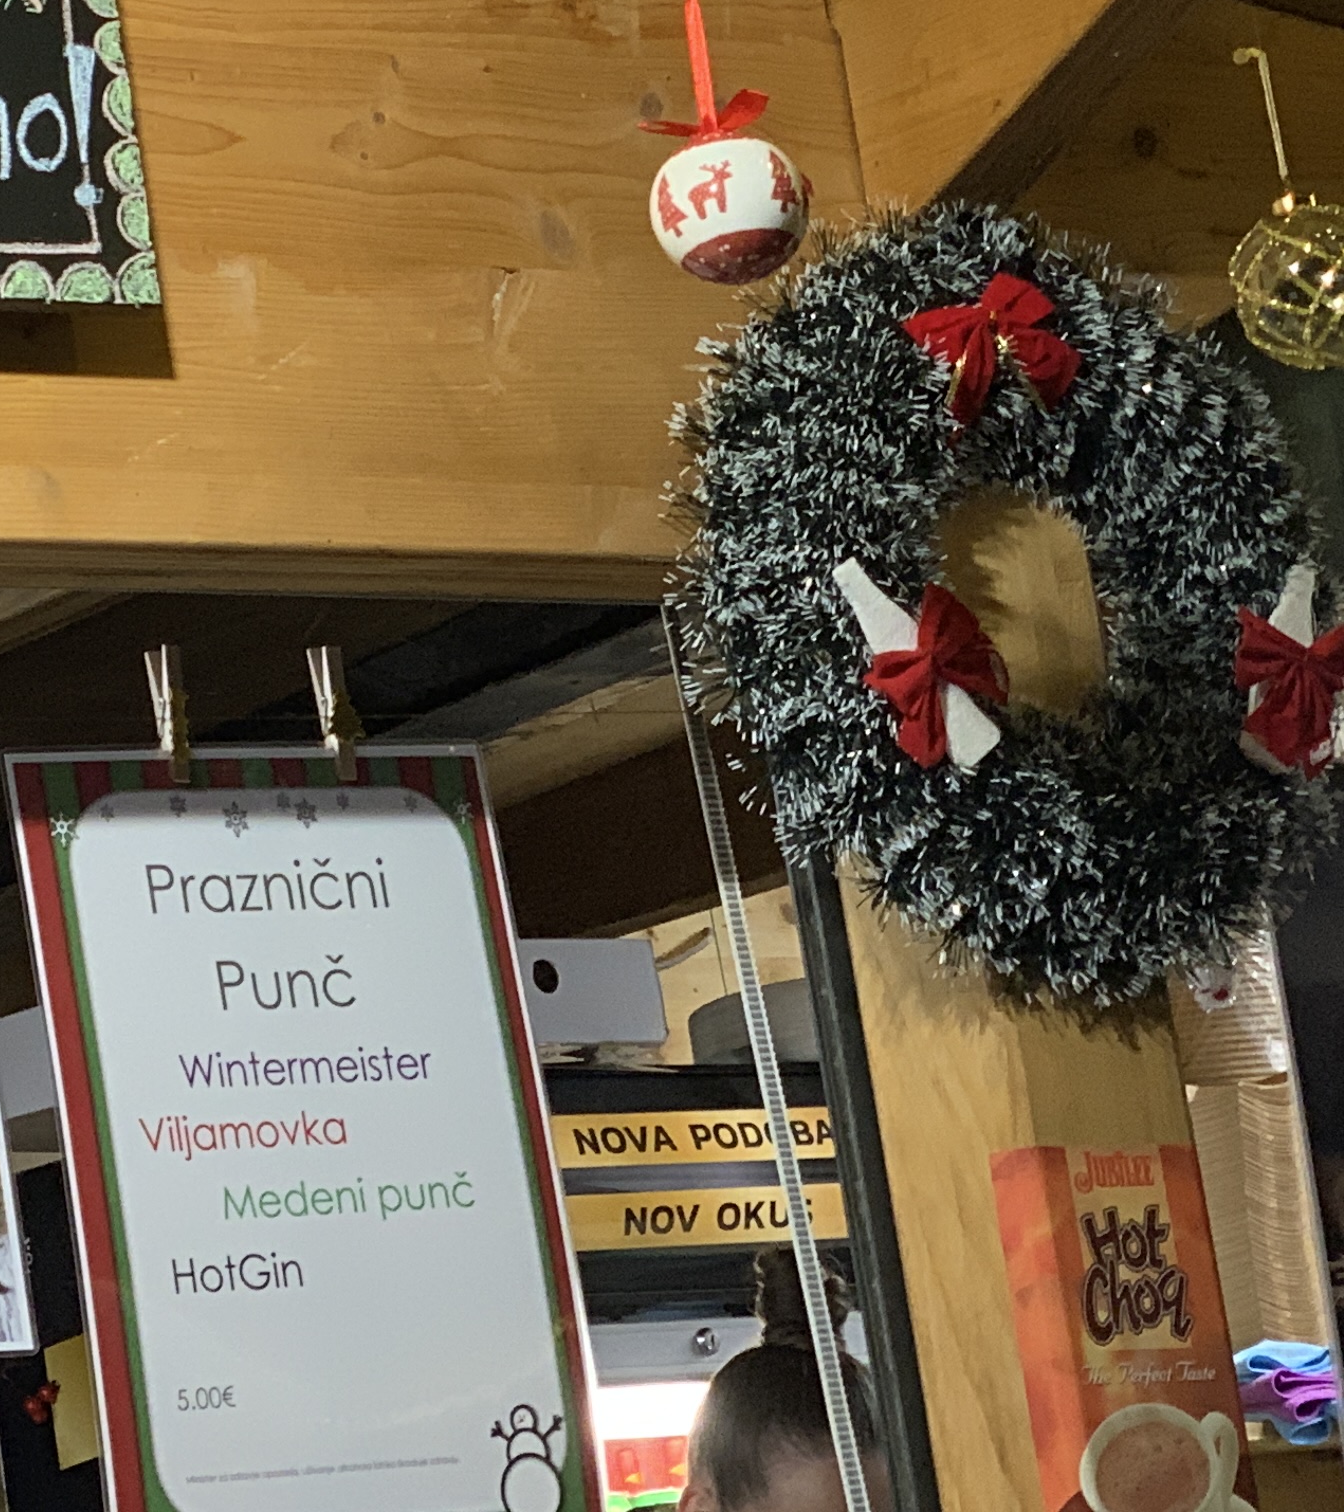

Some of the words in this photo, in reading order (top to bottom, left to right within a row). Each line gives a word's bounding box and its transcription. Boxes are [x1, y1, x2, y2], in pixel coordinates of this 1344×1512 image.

[144, 857, 391, 915] Praznični
[214, 955, 358, 1011] Punč
[179, 1048, 432, 1088] Wintermeister
[139, 1111, 348, 1160] Viljamovka
[573, 1125, 678, 1155] NOVA
[223, 1178, 367, 1220] Medeni
[378, 1171, 476, 1220] punč
[624, 1204, 700, 1236] NOV
[1080, 1204, 1170, 1272] Hot
[171, 1252, 306, 1294] HotGin
[1119, 1362, 1172, 1386] Perfect
[1175, 1361, 1216, 1382] Taste
[176, 1384, 237, 1411] 5.00€
